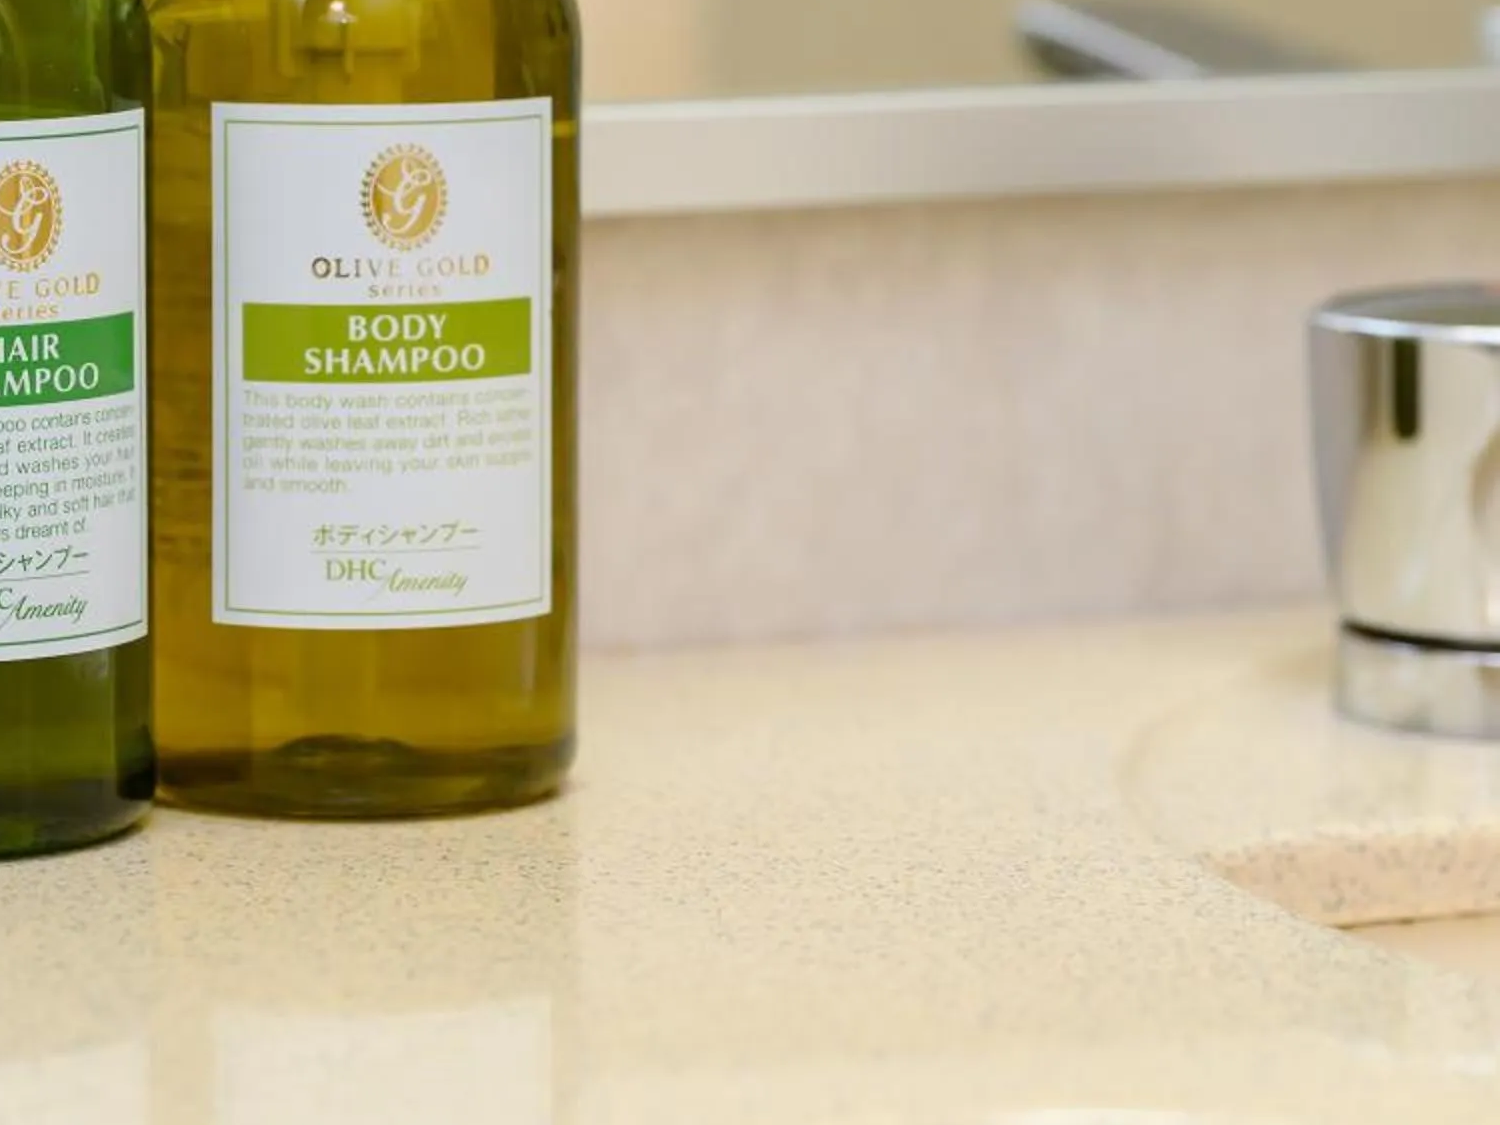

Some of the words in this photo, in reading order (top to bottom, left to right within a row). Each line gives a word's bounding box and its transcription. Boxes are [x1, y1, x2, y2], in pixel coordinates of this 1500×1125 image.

[312, 257, 399, 278] OLIVE
[417, 254, 489, 277] GOLD
[34, 272, 100, 297] GOLD
[348, 314, 447, 342] BODY
[304, 344, 485, 375] SHAMPOO
[31, 411, 91, 430] contains
[17, 436, 77, 453] extract.
[83, 430, 92, 445] It
[16, 456, 79, 475] washes
[53, 479, 67, 493] in
[28, 498, 57, 516] and
[63, 497, 89, 514] soft
[15, 519, 68, 539] dreamt
[313, 523, 478, 545] ボディシャンプー
[326, 559, 386, 580] DHC
[362, 567, 467, 604] Amenity
